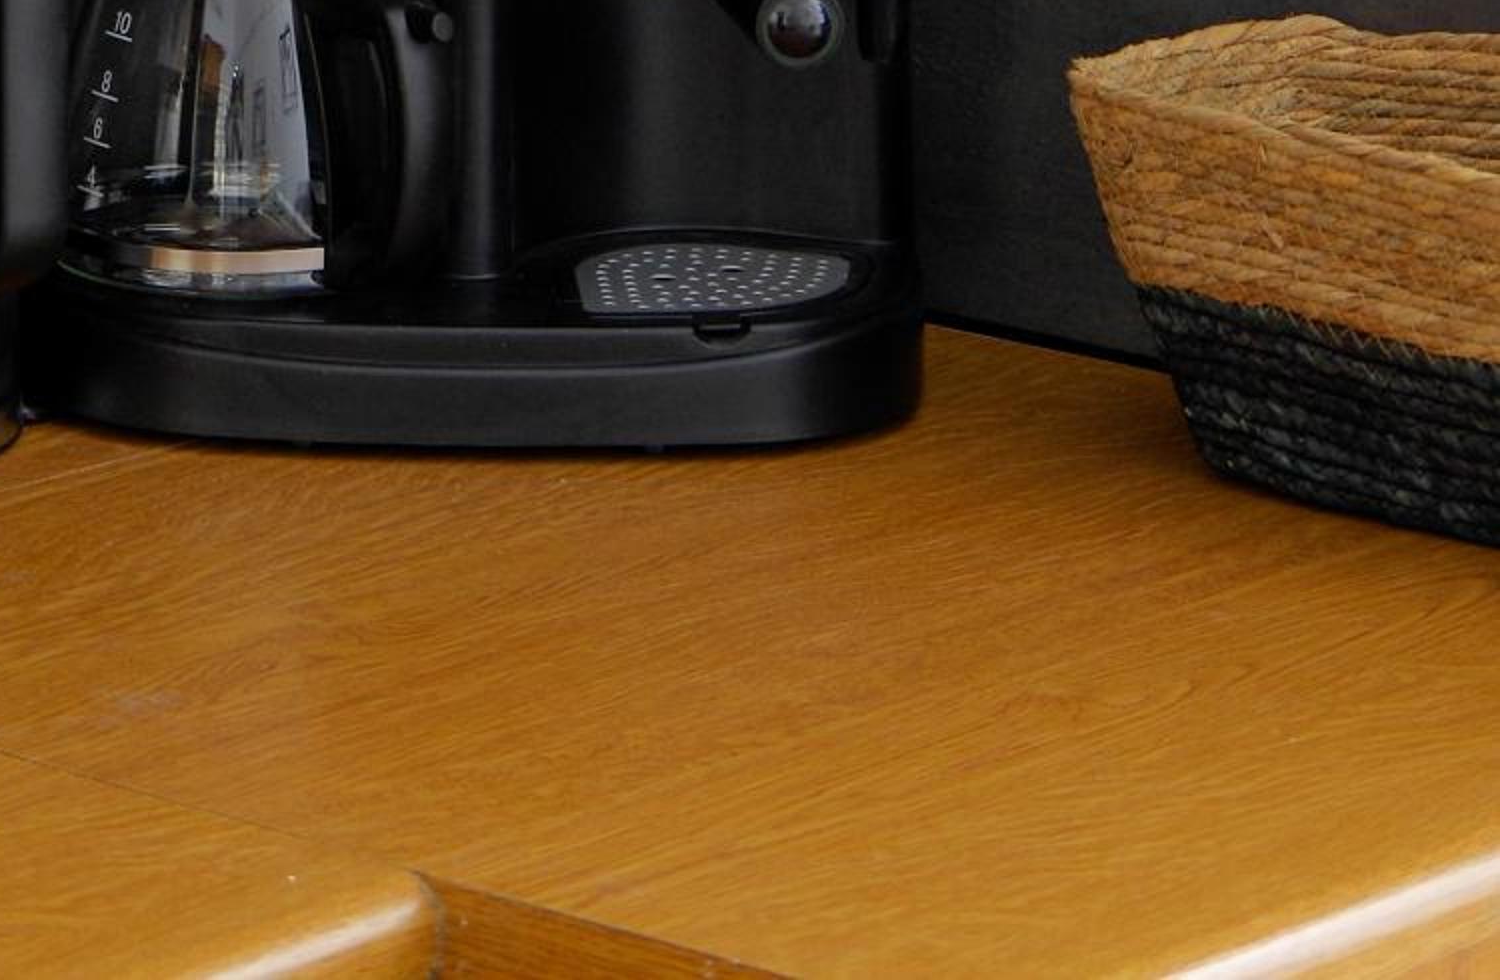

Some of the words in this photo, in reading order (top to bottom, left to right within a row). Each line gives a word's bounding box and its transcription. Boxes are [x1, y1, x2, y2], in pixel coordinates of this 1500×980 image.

[114, 11, 132, 34] 10
[101, 70, 113, 93] 8
[93, 117, 103, 139] 6
